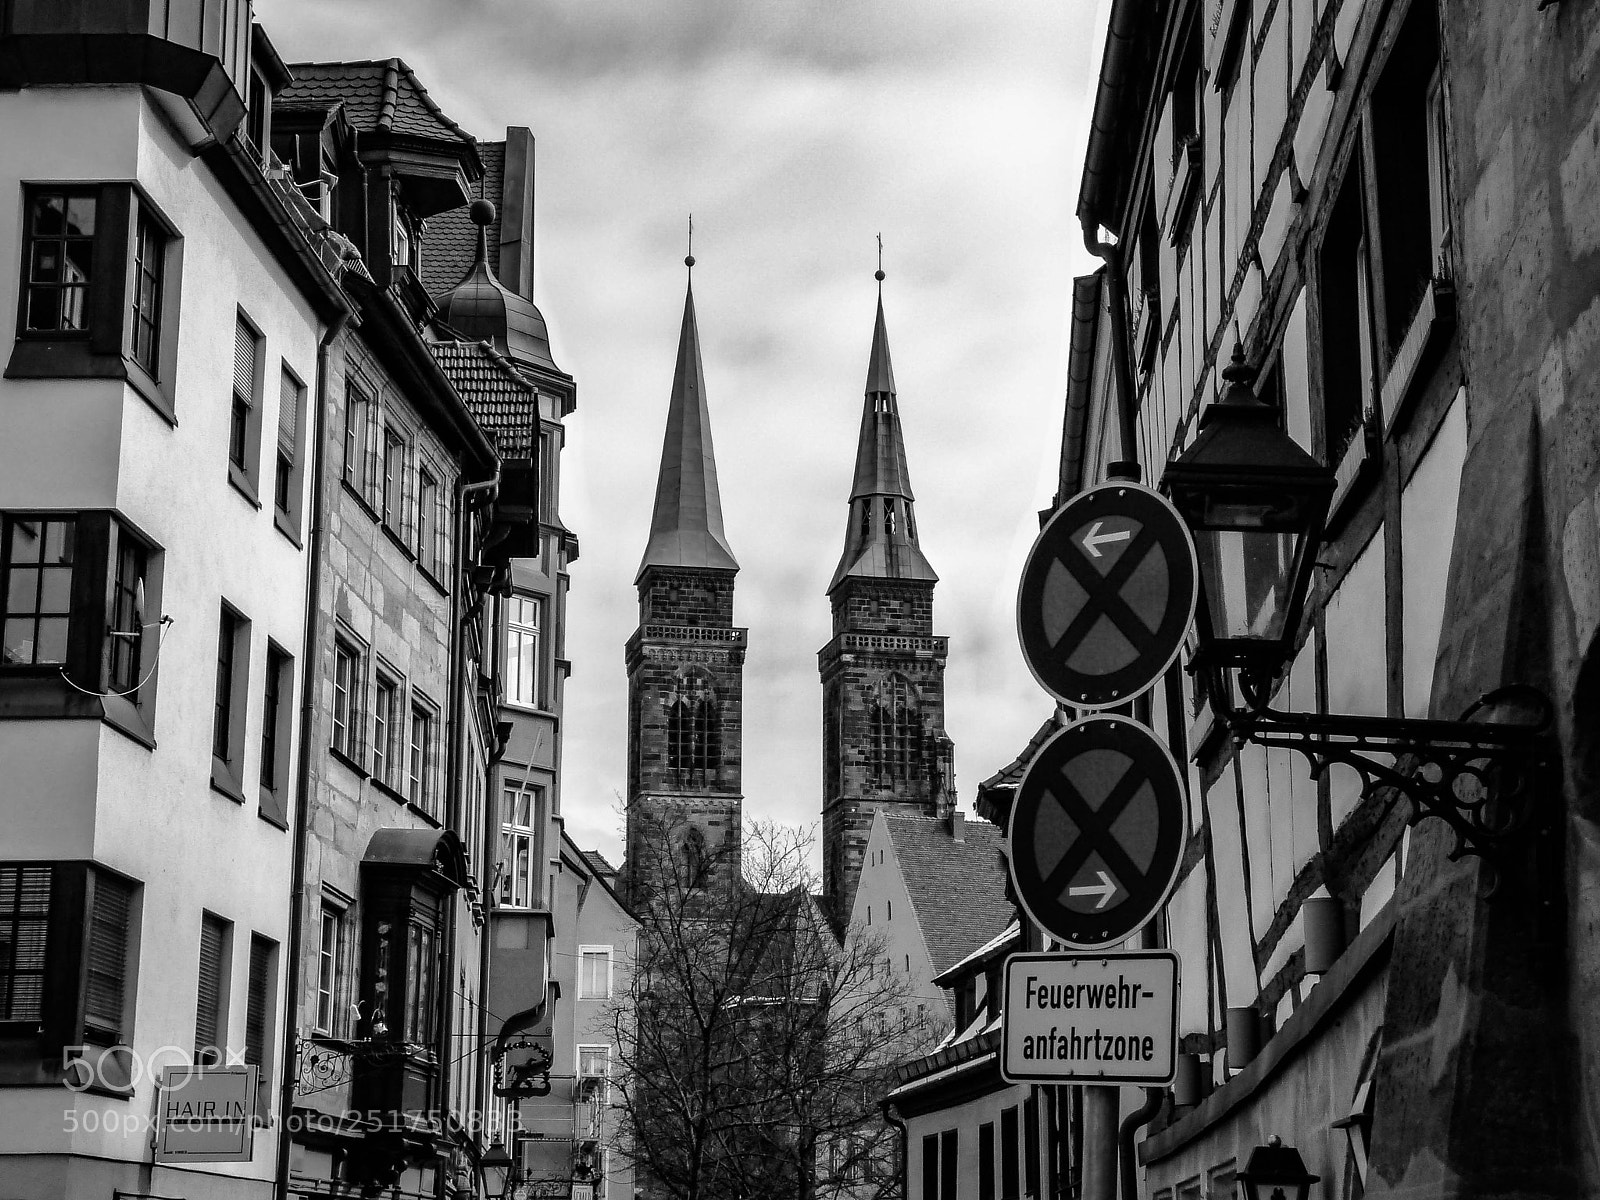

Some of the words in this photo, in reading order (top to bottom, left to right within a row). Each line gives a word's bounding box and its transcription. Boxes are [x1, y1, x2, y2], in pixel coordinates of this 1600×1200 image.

[1026, 975, 1154, 1009] Feuerwehr-
[1023, 1027, 1154, 1061] anfahrtzone
[166, 1101, 216, 1118] HAIR
[225, 1101, 246, 1118] IN
